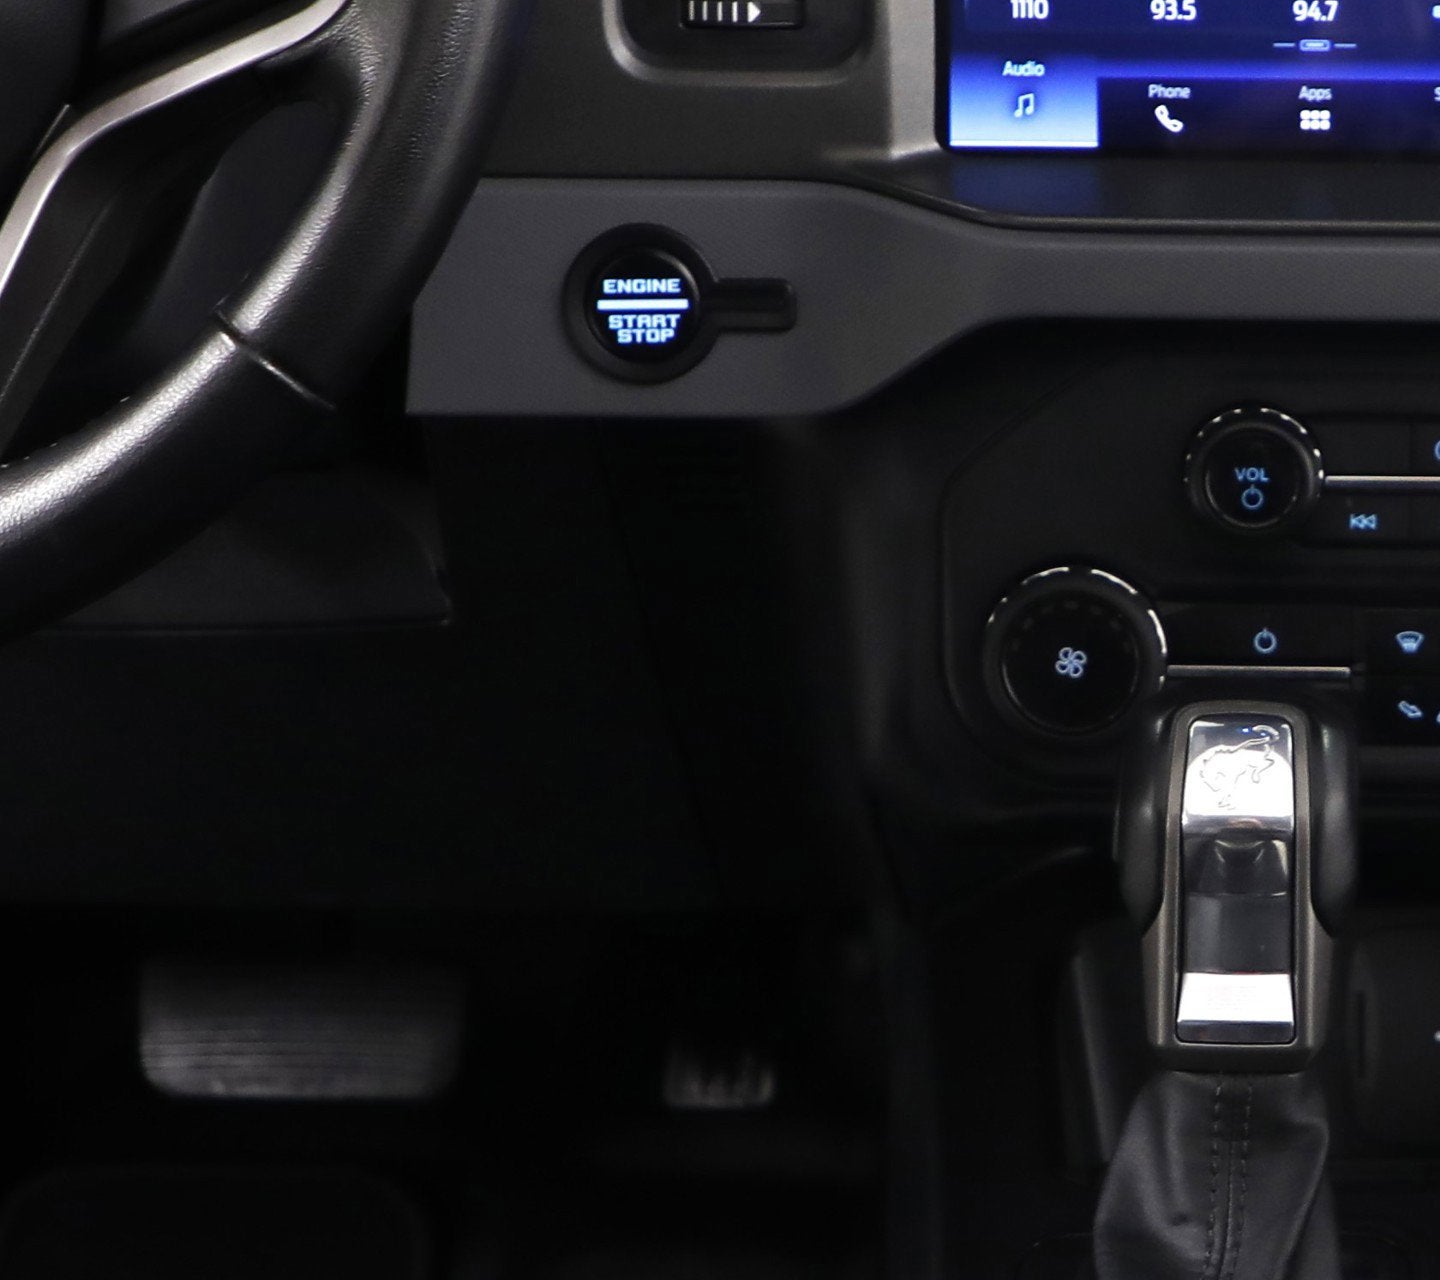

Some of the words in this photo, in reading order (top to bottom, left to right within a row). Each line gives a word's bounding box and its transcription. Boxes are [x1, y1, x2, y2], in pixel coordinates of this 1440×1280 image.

[1292, 0, 1340, 23] 94.7
[1002, 59, 1046, 78] Audio
[1147, 83, 1192, 99] Phone
[1298, 85, 1333, 103] Apps
[602, 277, 682, 296] ENGINE
[611, 328, 676, 345] STOP
[1235, 467, 1269, 483] VOL
